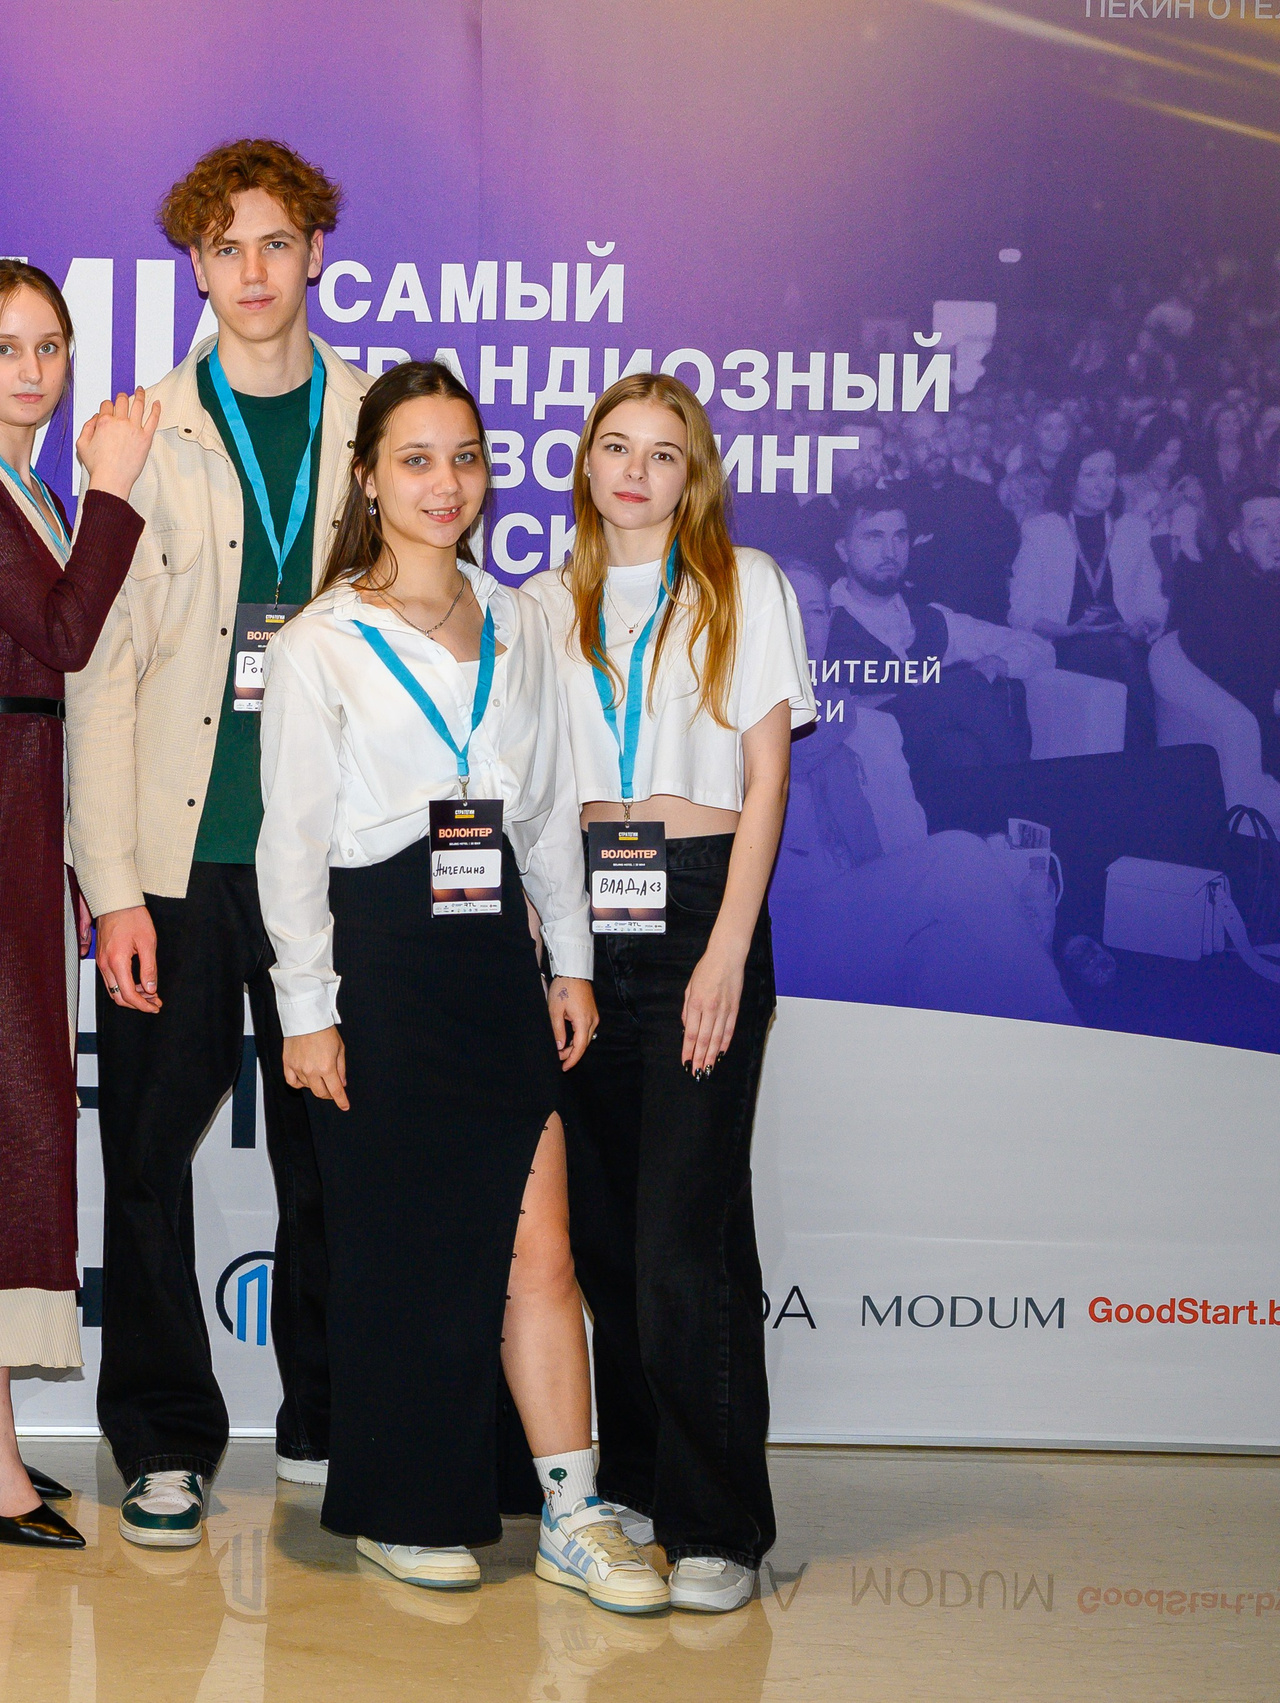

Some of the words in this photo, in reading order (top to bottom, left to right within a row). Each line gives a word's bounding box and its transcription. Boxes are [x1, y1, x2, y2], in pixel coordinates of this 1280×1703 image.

[1207, 0, 1280, 20] ОТЕ
[318, 240, 625, 324] САМЫЙ
[438, 828, 492, 838] ВОЛОНТЕР
[601, 849, 658, 860] ВОЛОНТЕР
[860, 1294, 1066, 1329] MODUM
